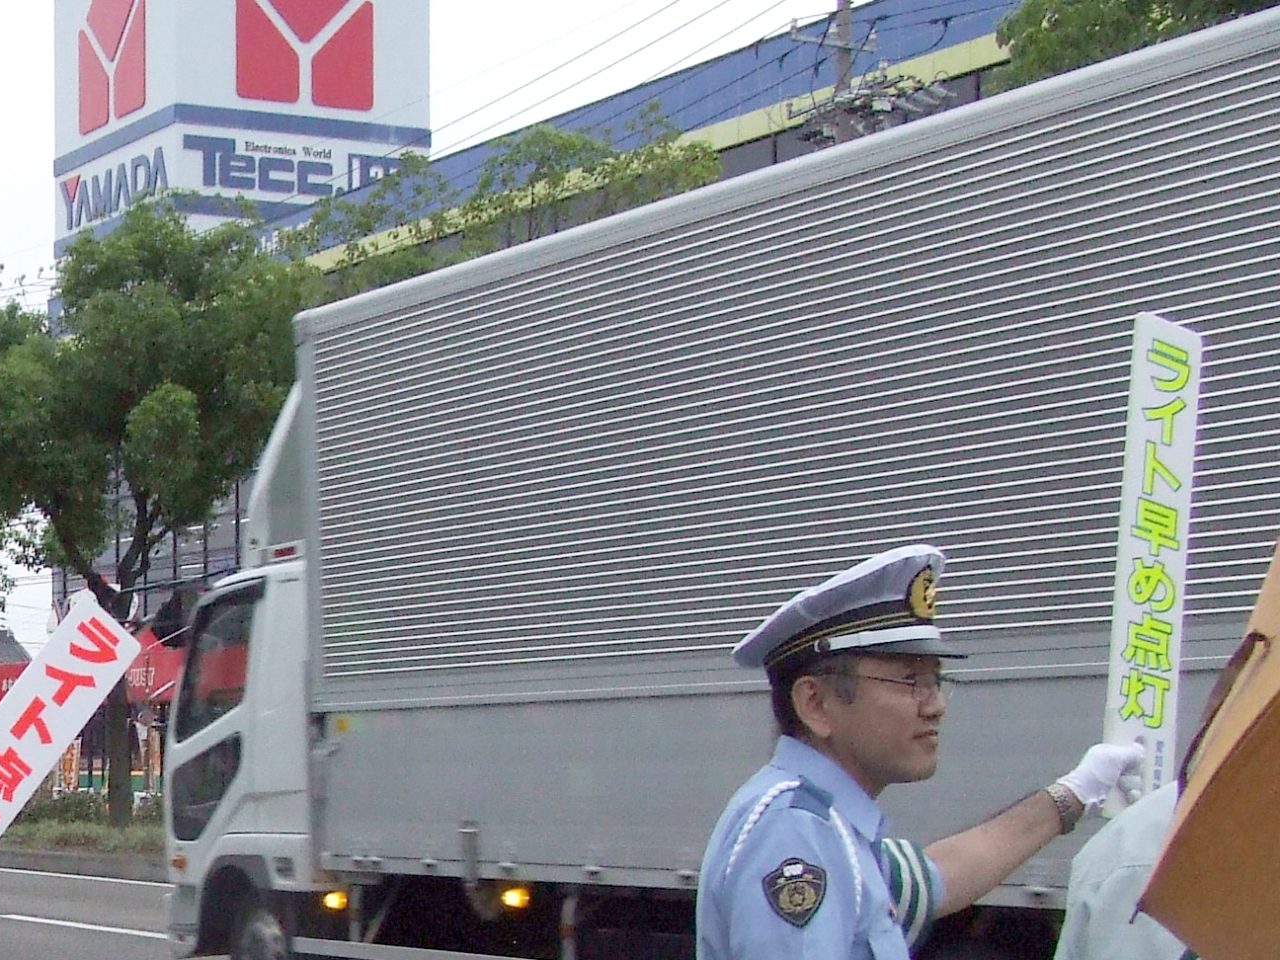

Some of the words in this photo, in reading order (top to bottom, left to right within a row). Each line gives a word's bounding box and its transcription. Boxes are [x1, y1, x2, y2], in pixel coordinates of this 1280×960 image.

[60, 146, 168, 230] YAMADA
[244, 141, 297, 156] Electronics
[302, 146, 332, 160] World
[1119, 337, 1190, 730] ライト早め点灯
